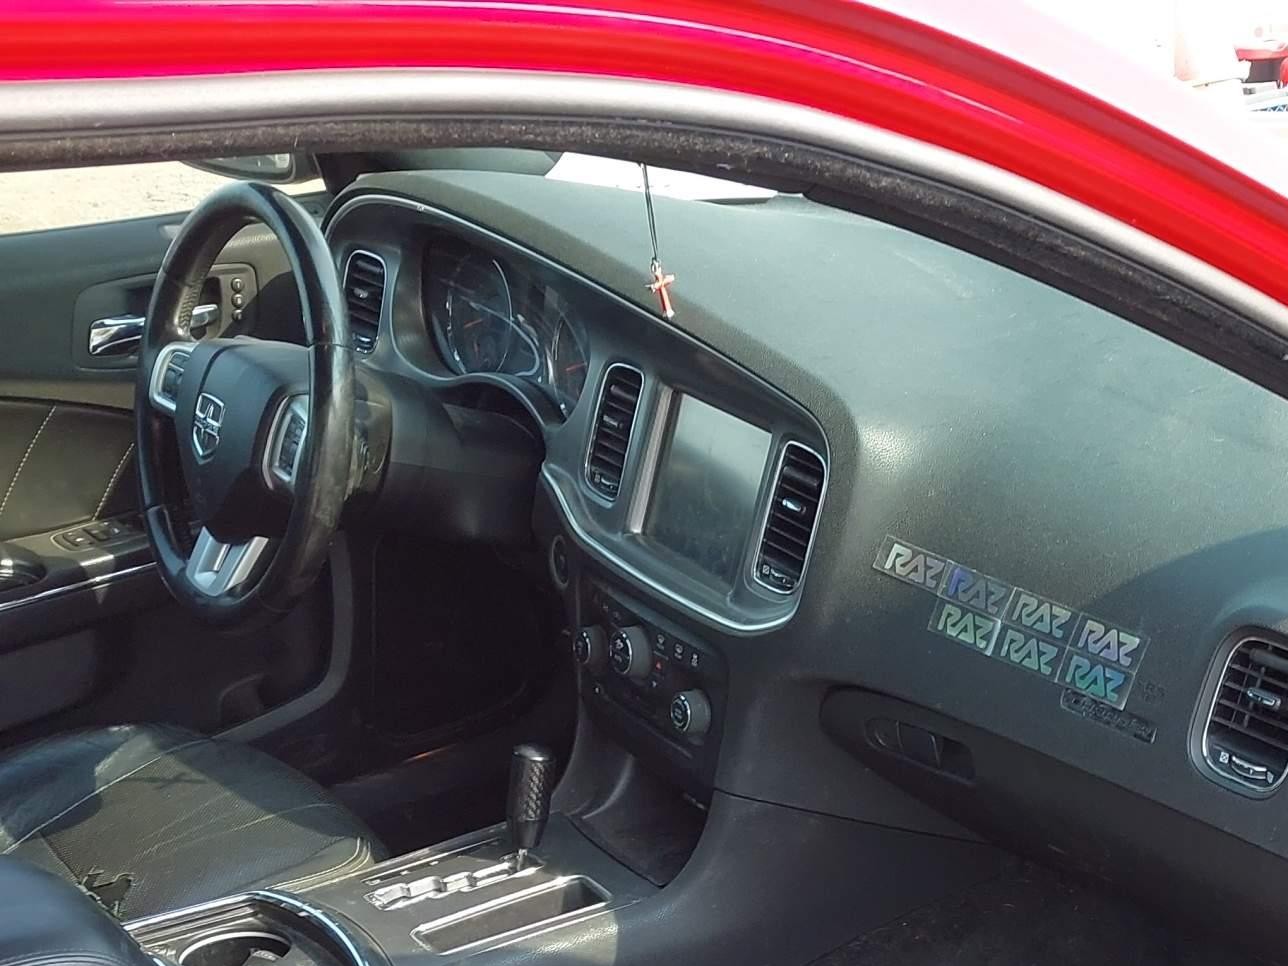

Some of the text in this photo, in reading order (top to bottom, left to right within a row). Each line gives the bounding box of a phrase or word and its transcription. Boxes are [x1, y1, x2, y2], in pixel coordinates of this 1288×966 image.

[884, 543, 945, 588] RAZ
[948, 567, 1007, 615] RAZ
[937, 603, 995, 649] RAZ
[1012, 594, 1072, 638] RAZ
[1000, 629, 1058, 675] RAZ
[1078, 620, 1140, 667] RAZ
[1065, 655, 1125, 701] RAZ
